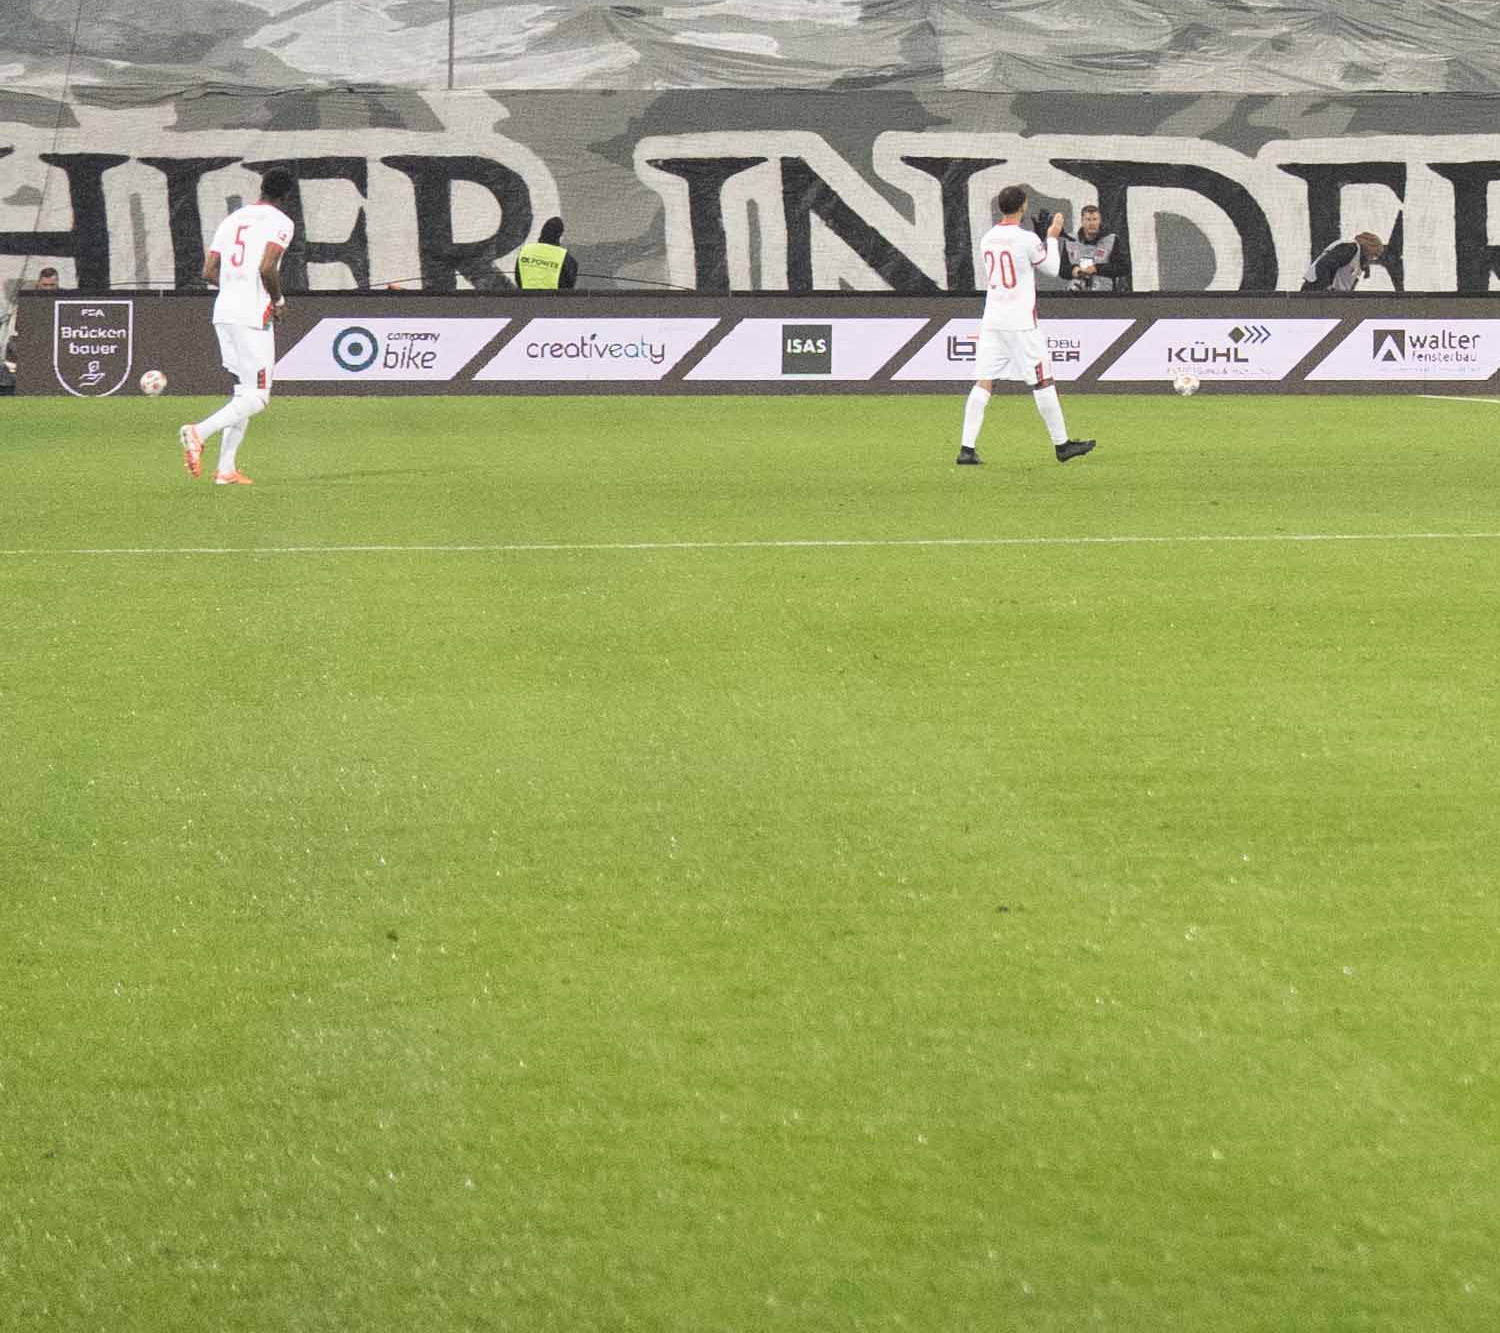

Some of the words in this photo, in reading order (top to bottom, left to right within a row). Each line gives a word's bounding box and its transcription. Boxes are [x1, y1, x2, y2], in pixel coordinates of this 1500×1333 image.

[645, 155, 1007, 291] IN
[230, 224, 251, 268] 5
[983, 249, 1018, 290] 20
[61, 325, 127, 339] Brücken
[387, 331, 441, 343] company
[1409, 329, 1481, 349] walter
[69, 342, 118, 355] bauer
[383, 343, 438, 370] bike
[526, 333, 665, 365] creativeaty
[786, 338, 827, 354] ISAS
[1167, 340, 1249, 363] KÜHL
